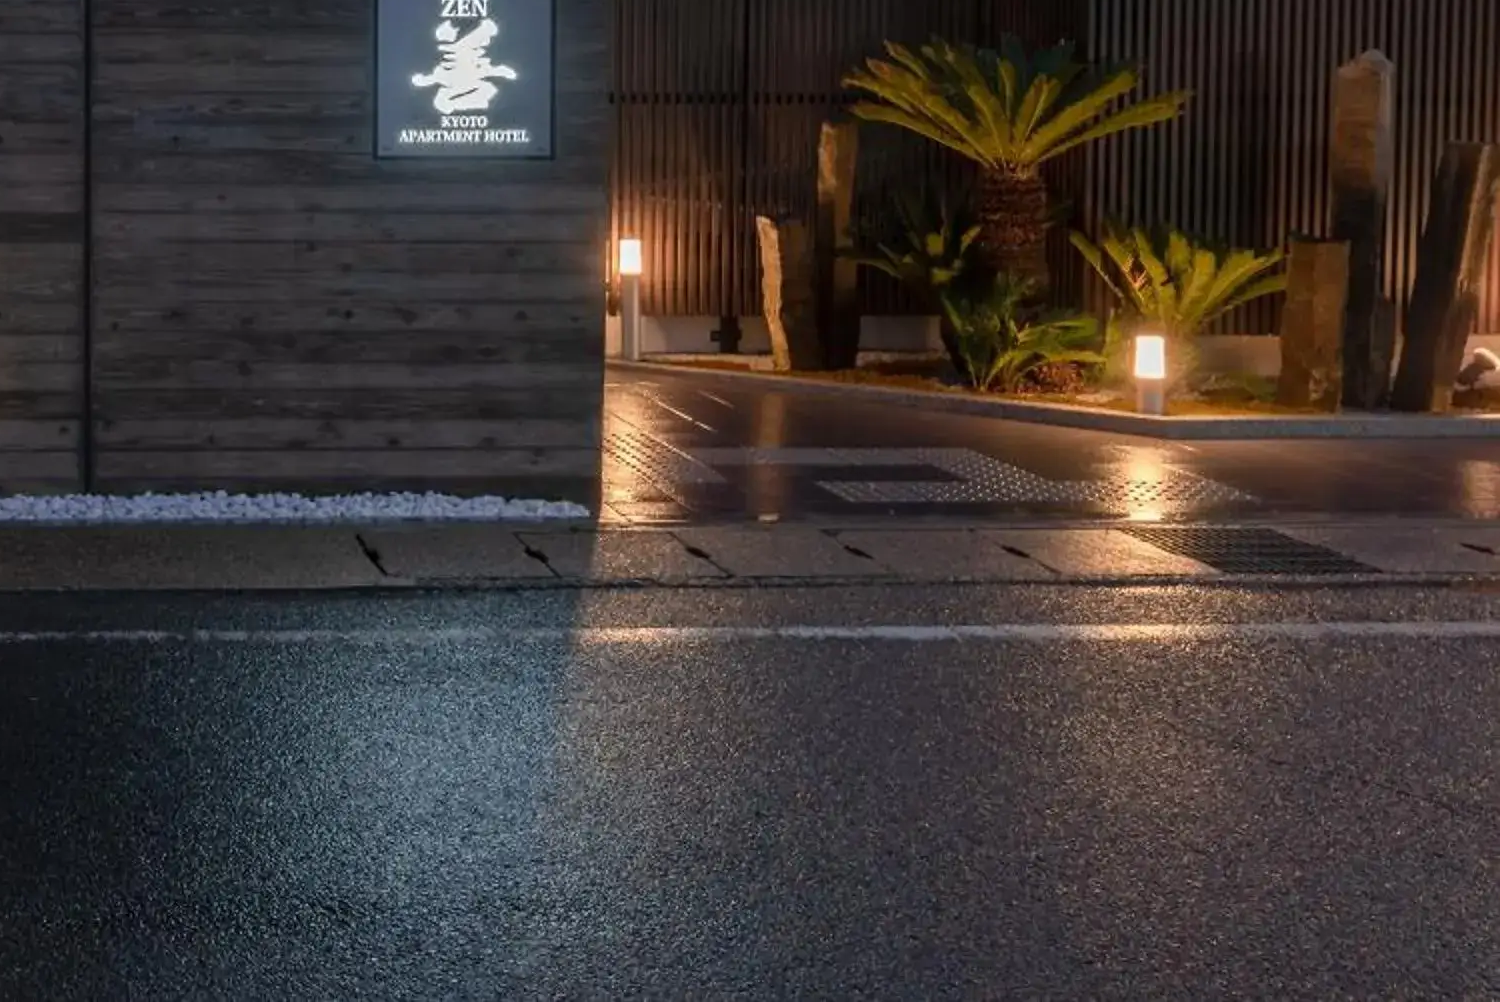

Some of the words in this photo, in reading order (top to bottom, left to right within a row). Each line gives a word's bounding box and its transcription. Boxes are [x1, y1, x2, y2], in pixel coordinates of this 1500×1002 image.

[440, 115, 489, 129] KYOTO
[399, 129, 482, 143] APARTMENT
[484, 129, 530, 143] HOTEL
